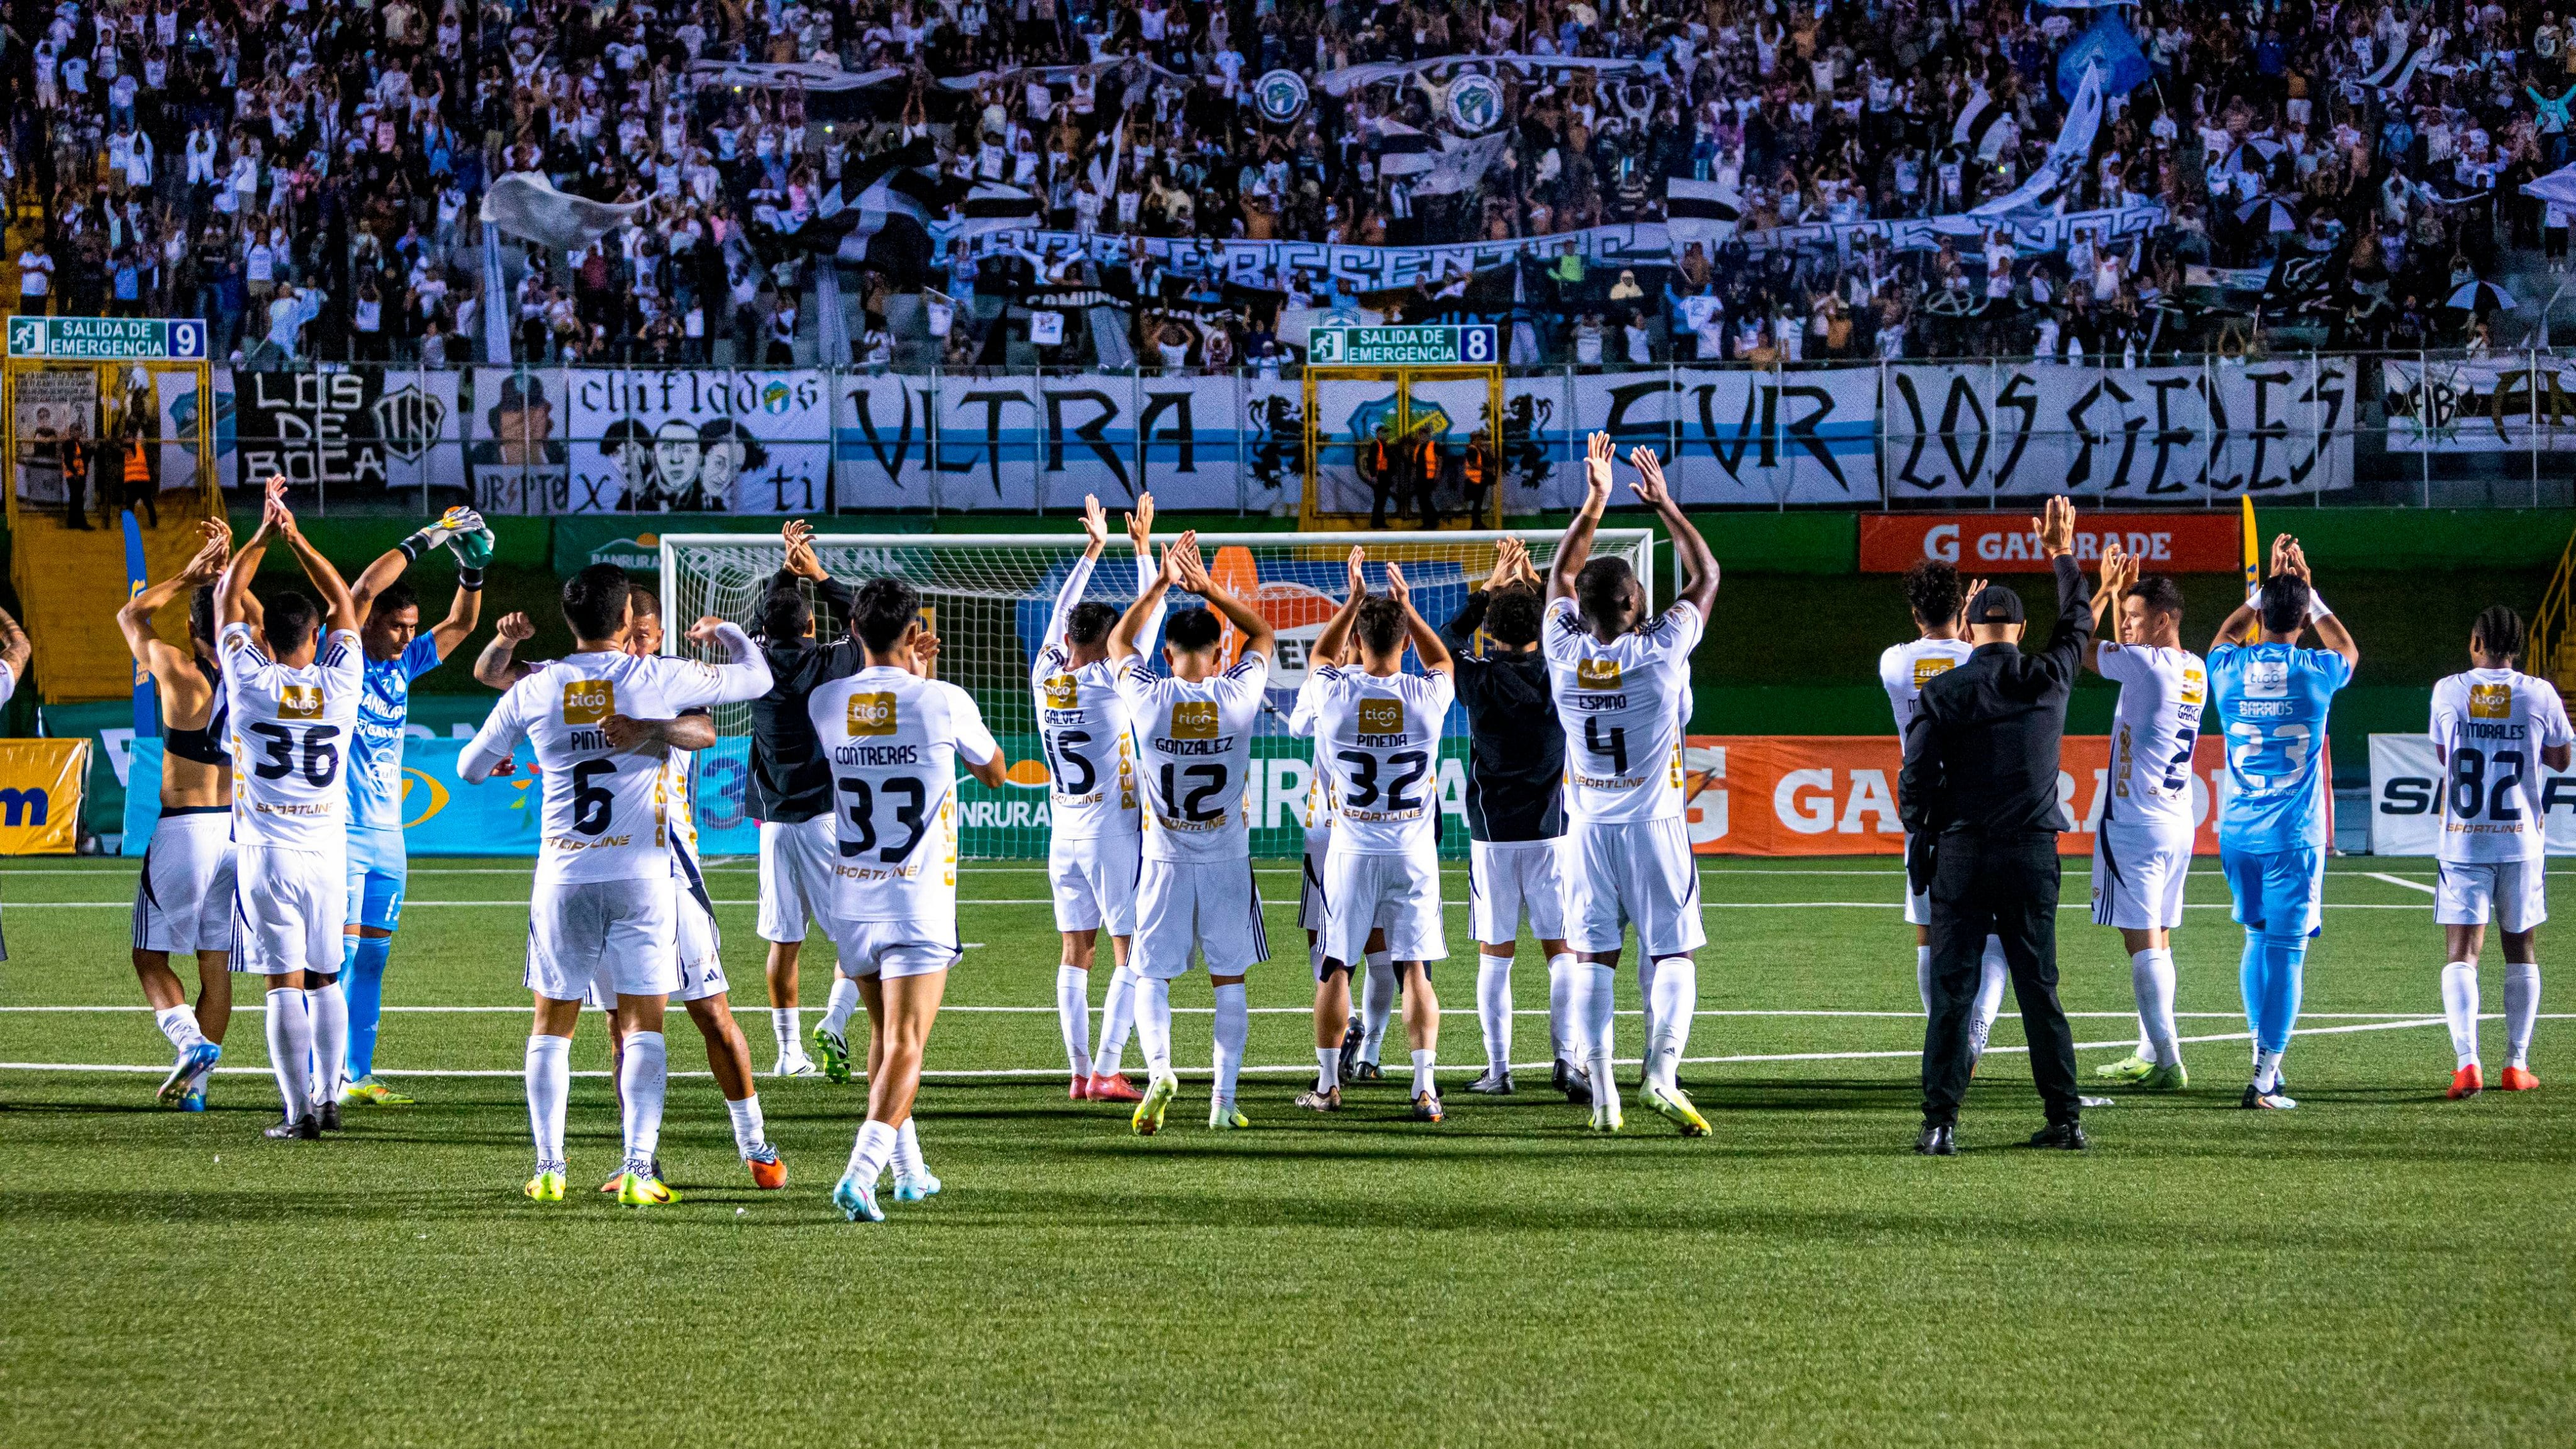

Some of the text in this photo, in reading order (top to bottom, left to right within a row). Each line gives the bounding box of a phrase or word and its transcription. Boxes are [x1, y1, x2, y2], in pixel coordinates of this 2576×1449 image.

[63, 320, 152, 338] SALIDA DE
[176, 322, 196, 355] 9
[1359, 328, 1445, 346] SALIDA DE
[1468, 330, 1487, 360] 8
[51, 339, 164, 356] EMERGENCIA
[1348, 346, 1457, 362] EMERGENCIA
[257, 372, 364, 409] LOS
[277, 413, 347, 447] DE
[1896, 372, 2038, 490] LOS
[245, 447, 387, 485] BOCA
[1923, 523, 1960, 563] G
[1579, 695, 1628, 710] ESPINO
[2239, 700, 2294, 716] BARRIOS
[1357, 734, 1408, 748] PINEDA
[1584, 716, 1628, 777] 4
[2466, 723, 2526, 740] MORALES
[248, 721, 341, 788] 36
[835, 745, 918, 766] CONTRERAS
[1044, 728, 1096, 795] 15
[1119, 731, 1137, 810] PEPSI
[2162, 728, 2196, 791] 2
[2229, 722, 2311, 788] 23
[572, 758, 618, 836] 6
[1160, 763, 1228, 822] 12
[1337, 750, 1429, 811] 32
[1574, 773, 1647, 789] SPORTLINE
[2451, 747, 2525, 821] 82
[837, 776, 926, 863] 33
[958, 801, 1051, 827] NRURA
[1343, 808, 1421, 822] SPORTLINE
[2446, 823, 2524, 834] SPORTLINE
